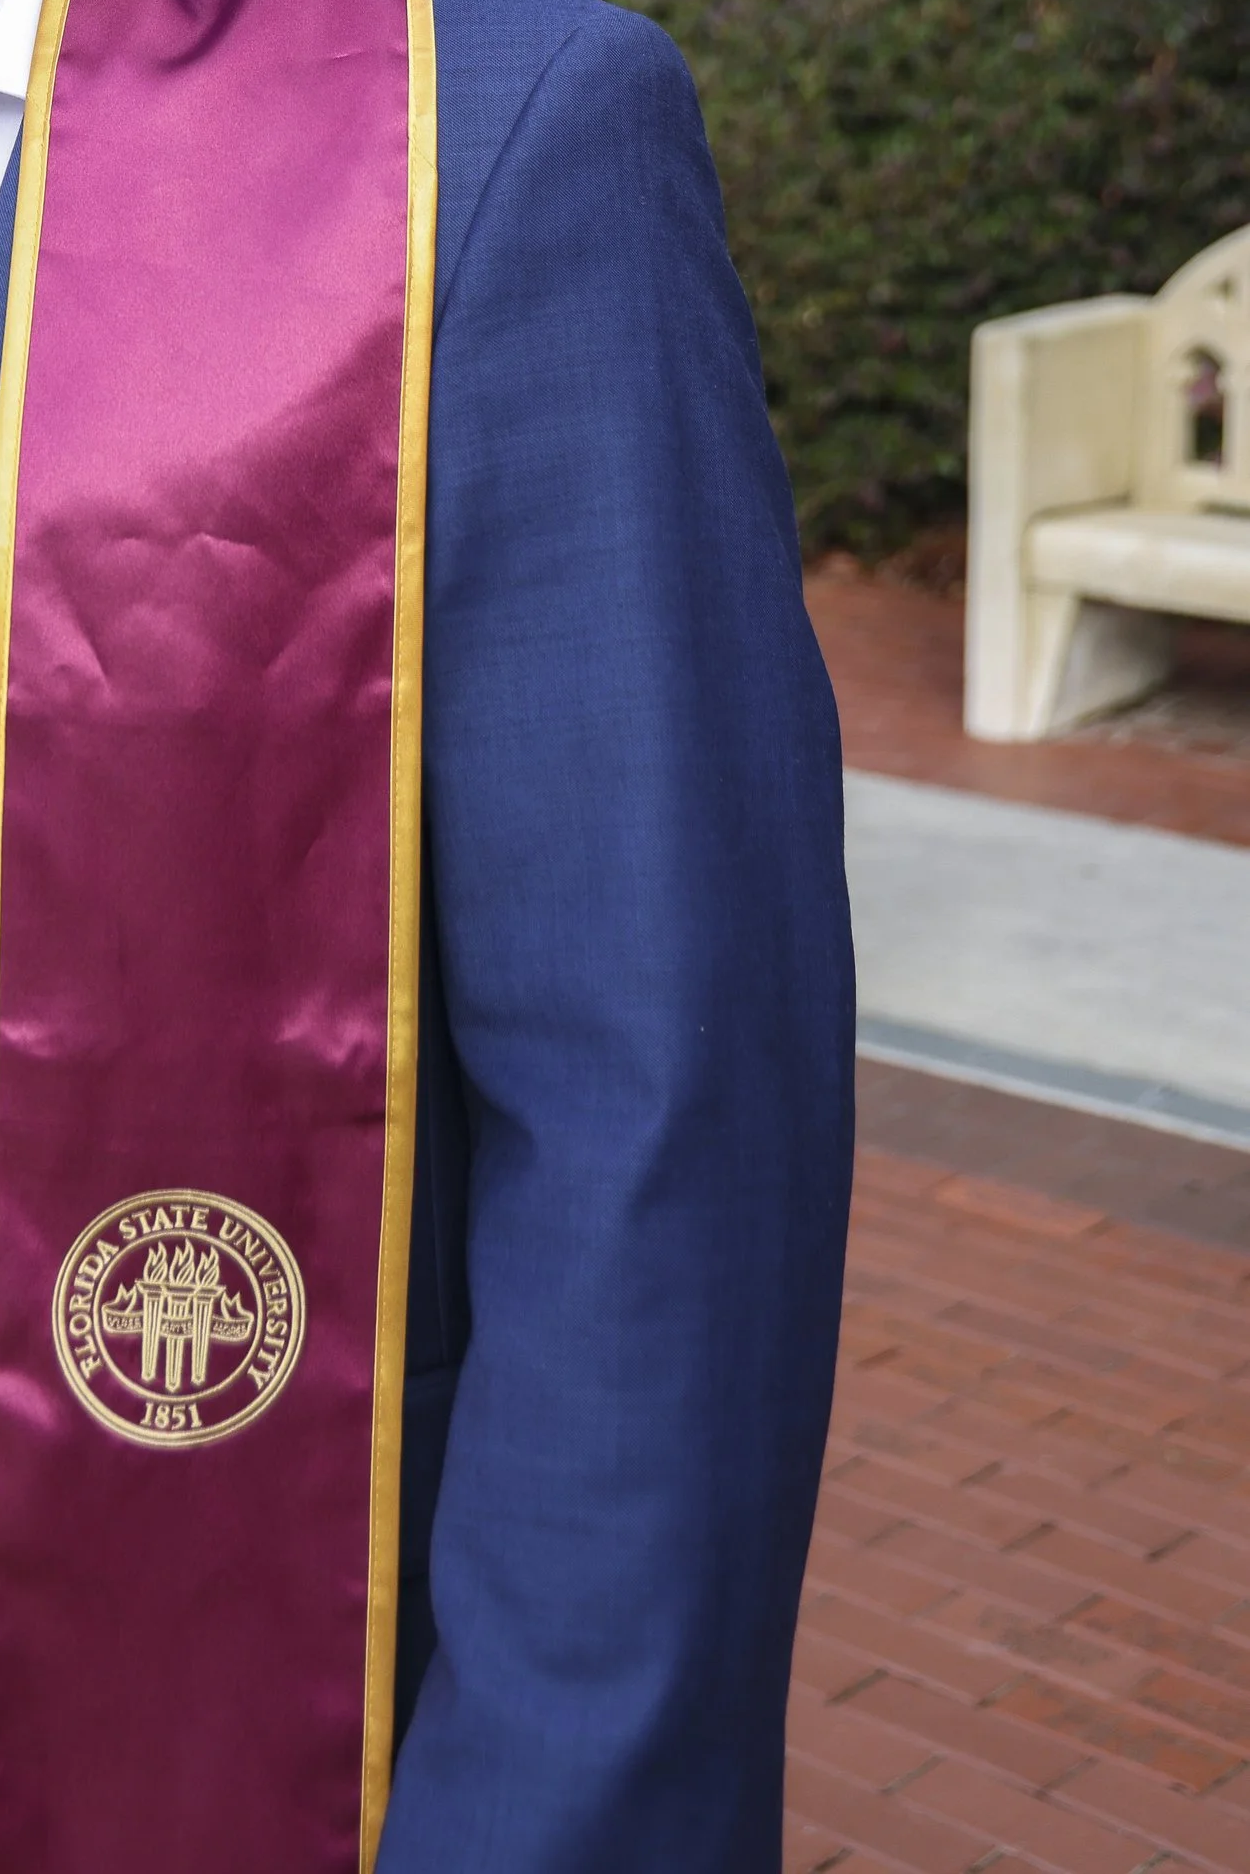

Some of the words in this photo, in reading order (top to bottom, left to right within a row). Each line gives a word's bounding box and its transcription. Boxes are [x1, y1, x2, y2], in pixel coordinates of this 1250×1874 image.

[68, 1238, 120, 1379] FLORIDA
[118, 1204, 210, 1241] STATE
[218, 1216, 289, 1390] UNIVERSITY
[140, 1402, 203, 1431] 1851
